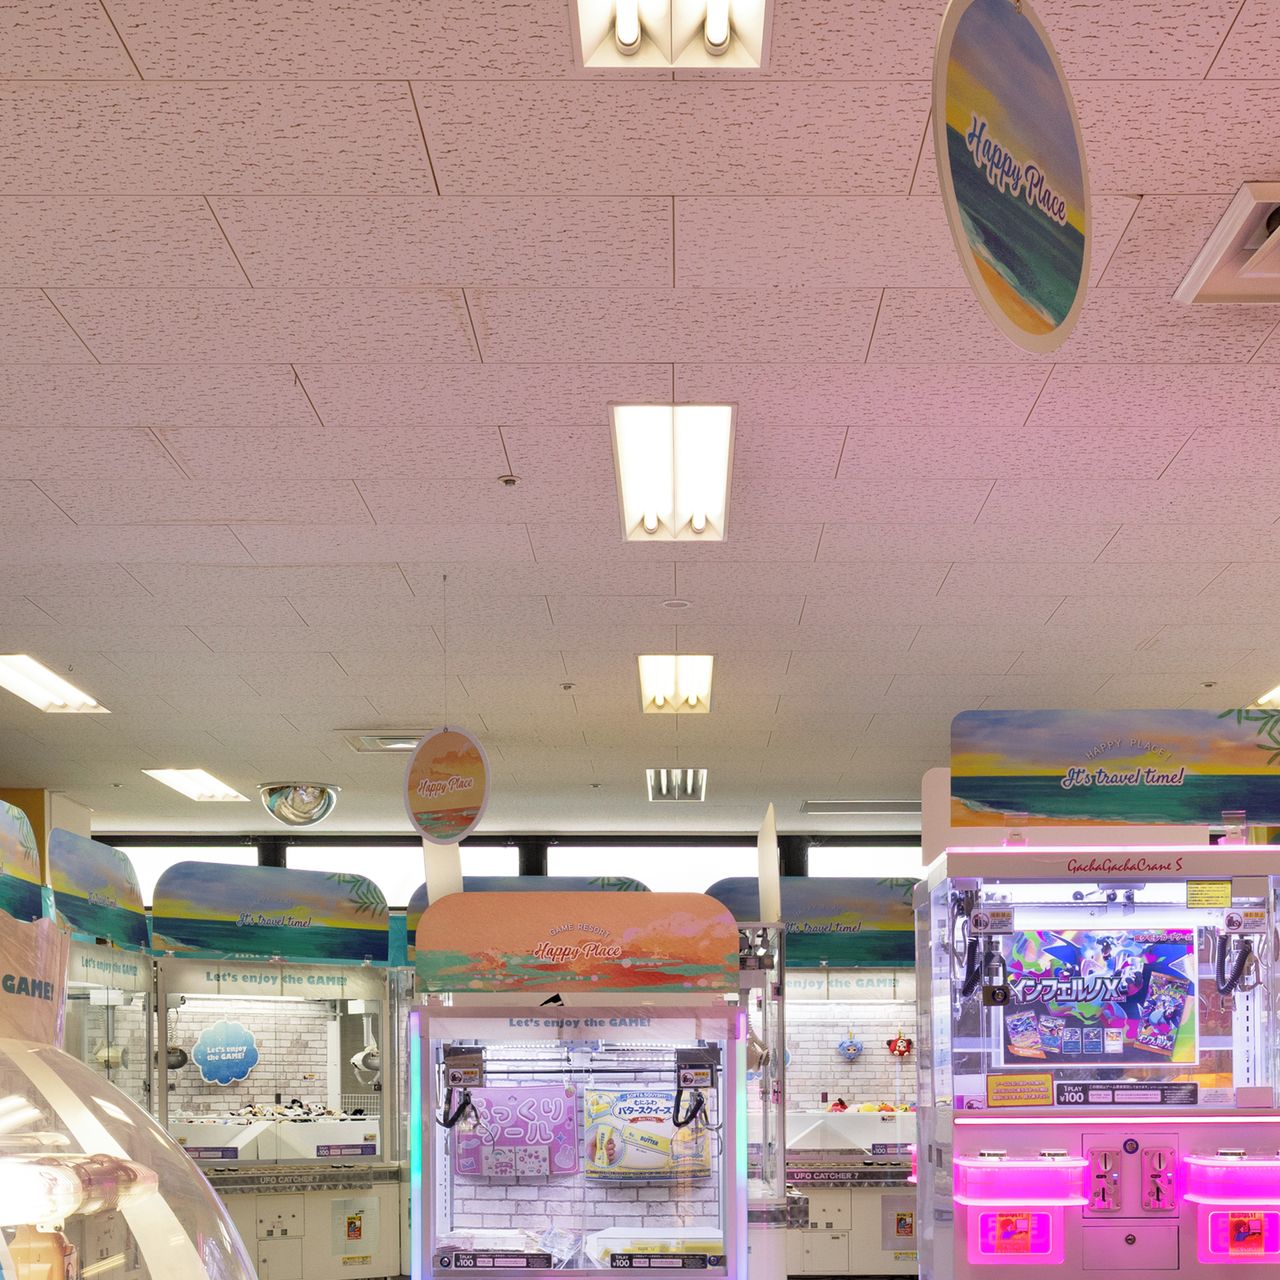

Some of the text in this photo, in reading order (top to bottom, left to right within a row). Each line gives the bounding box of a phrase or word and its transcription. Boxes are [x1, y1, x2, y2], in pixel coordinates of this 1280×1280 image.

[968, 113, 1067, 223] Happy Place
[1085, 738, 1172, 761] HAPPY PLACE!
[1062, 767, 1186, 788] It's travel time!
[416, 776, 474, 799] Happy Place
[255, 912, 285, 926] travel
[288, 916, 313, 928] time!
[803, 921, 834, 934] travel
[835, 921, 862, 934] time!
[548, 923, 612, 938] GAME RESORT
[533, 941, 623, 962] Happy Place
[206, 971, 348, 987] Let's enjoy the GAME!
[827, 977, 853, 989] the
[1, 973, 55, 1002] GAME!
[508, 1017, 652, 1030] Let's enjoy the GAME!
[207, 1045, 248, 1056] Let's enjoy
[1060, 1092, 1085, 1103] ¥100
[794, 1172, 860, 1180] UFO CATCHER 7
